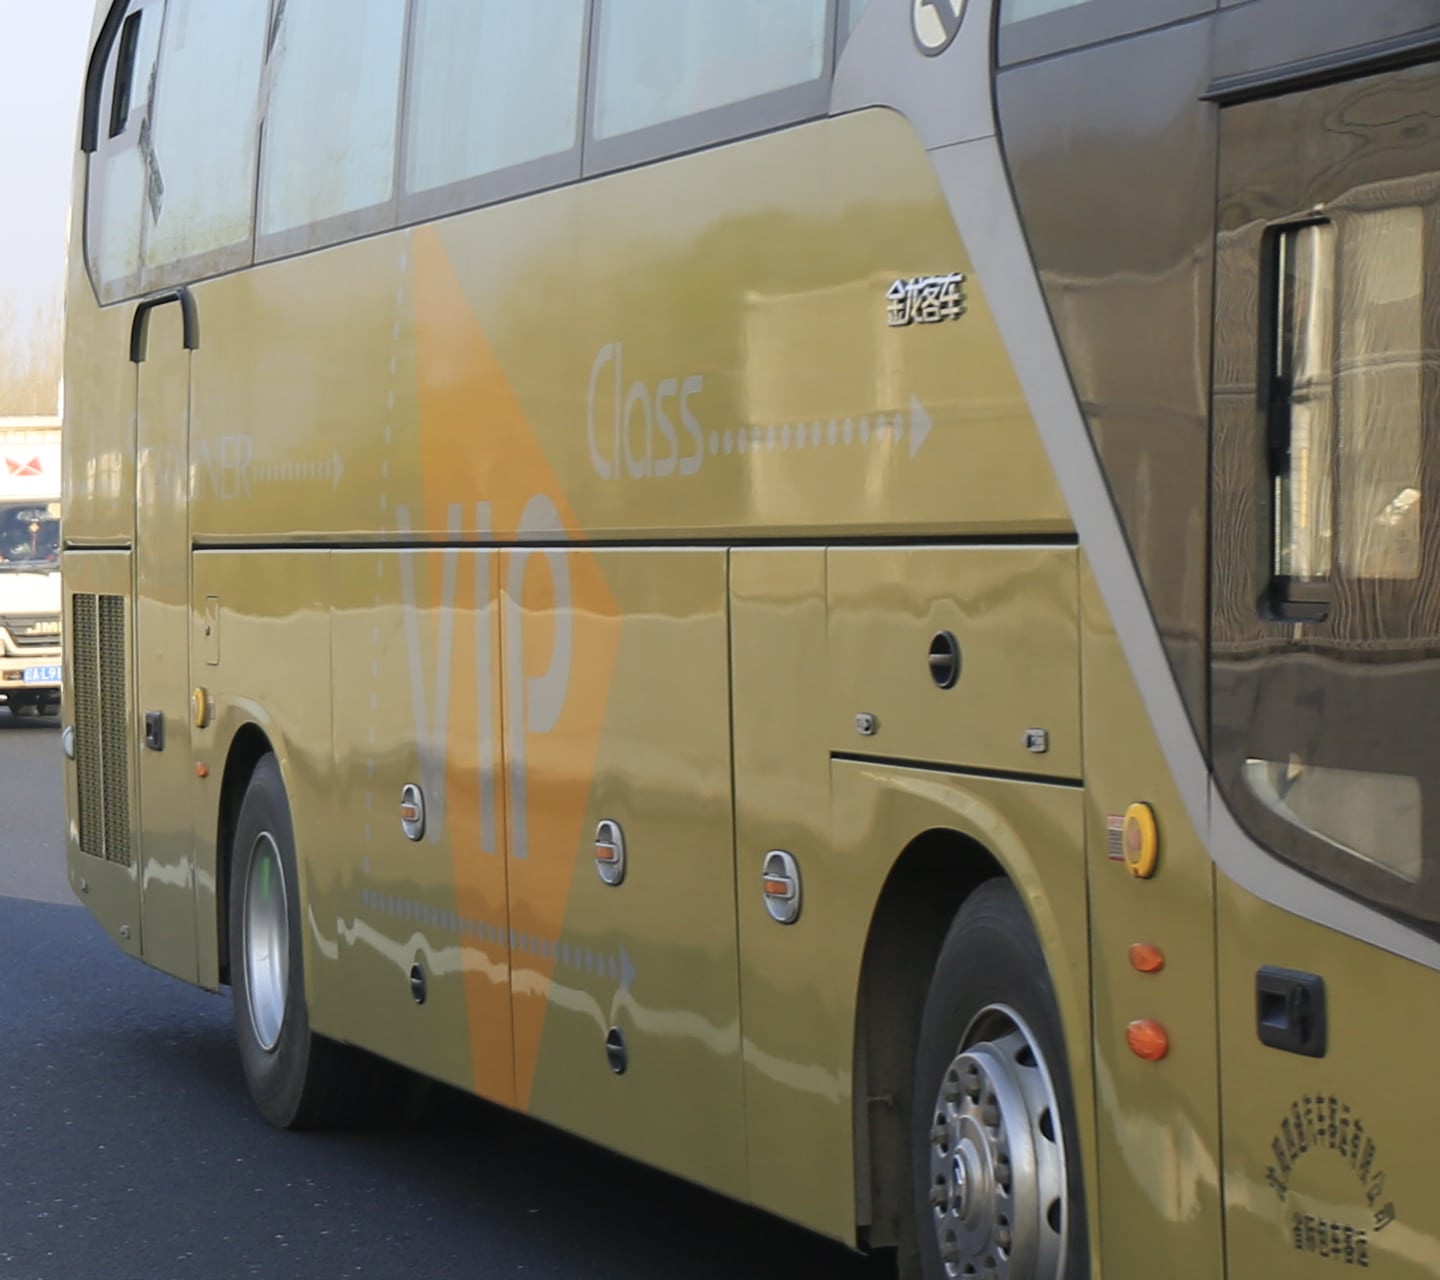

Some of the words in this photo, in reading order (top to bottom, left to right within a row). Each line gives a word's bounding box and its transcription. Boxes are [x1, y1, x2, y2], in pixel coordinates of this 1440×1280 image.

[586, 341, 705, 480] Class
[25, 621, 62, 634] JM
[395, 492, 573, 861] VIP
